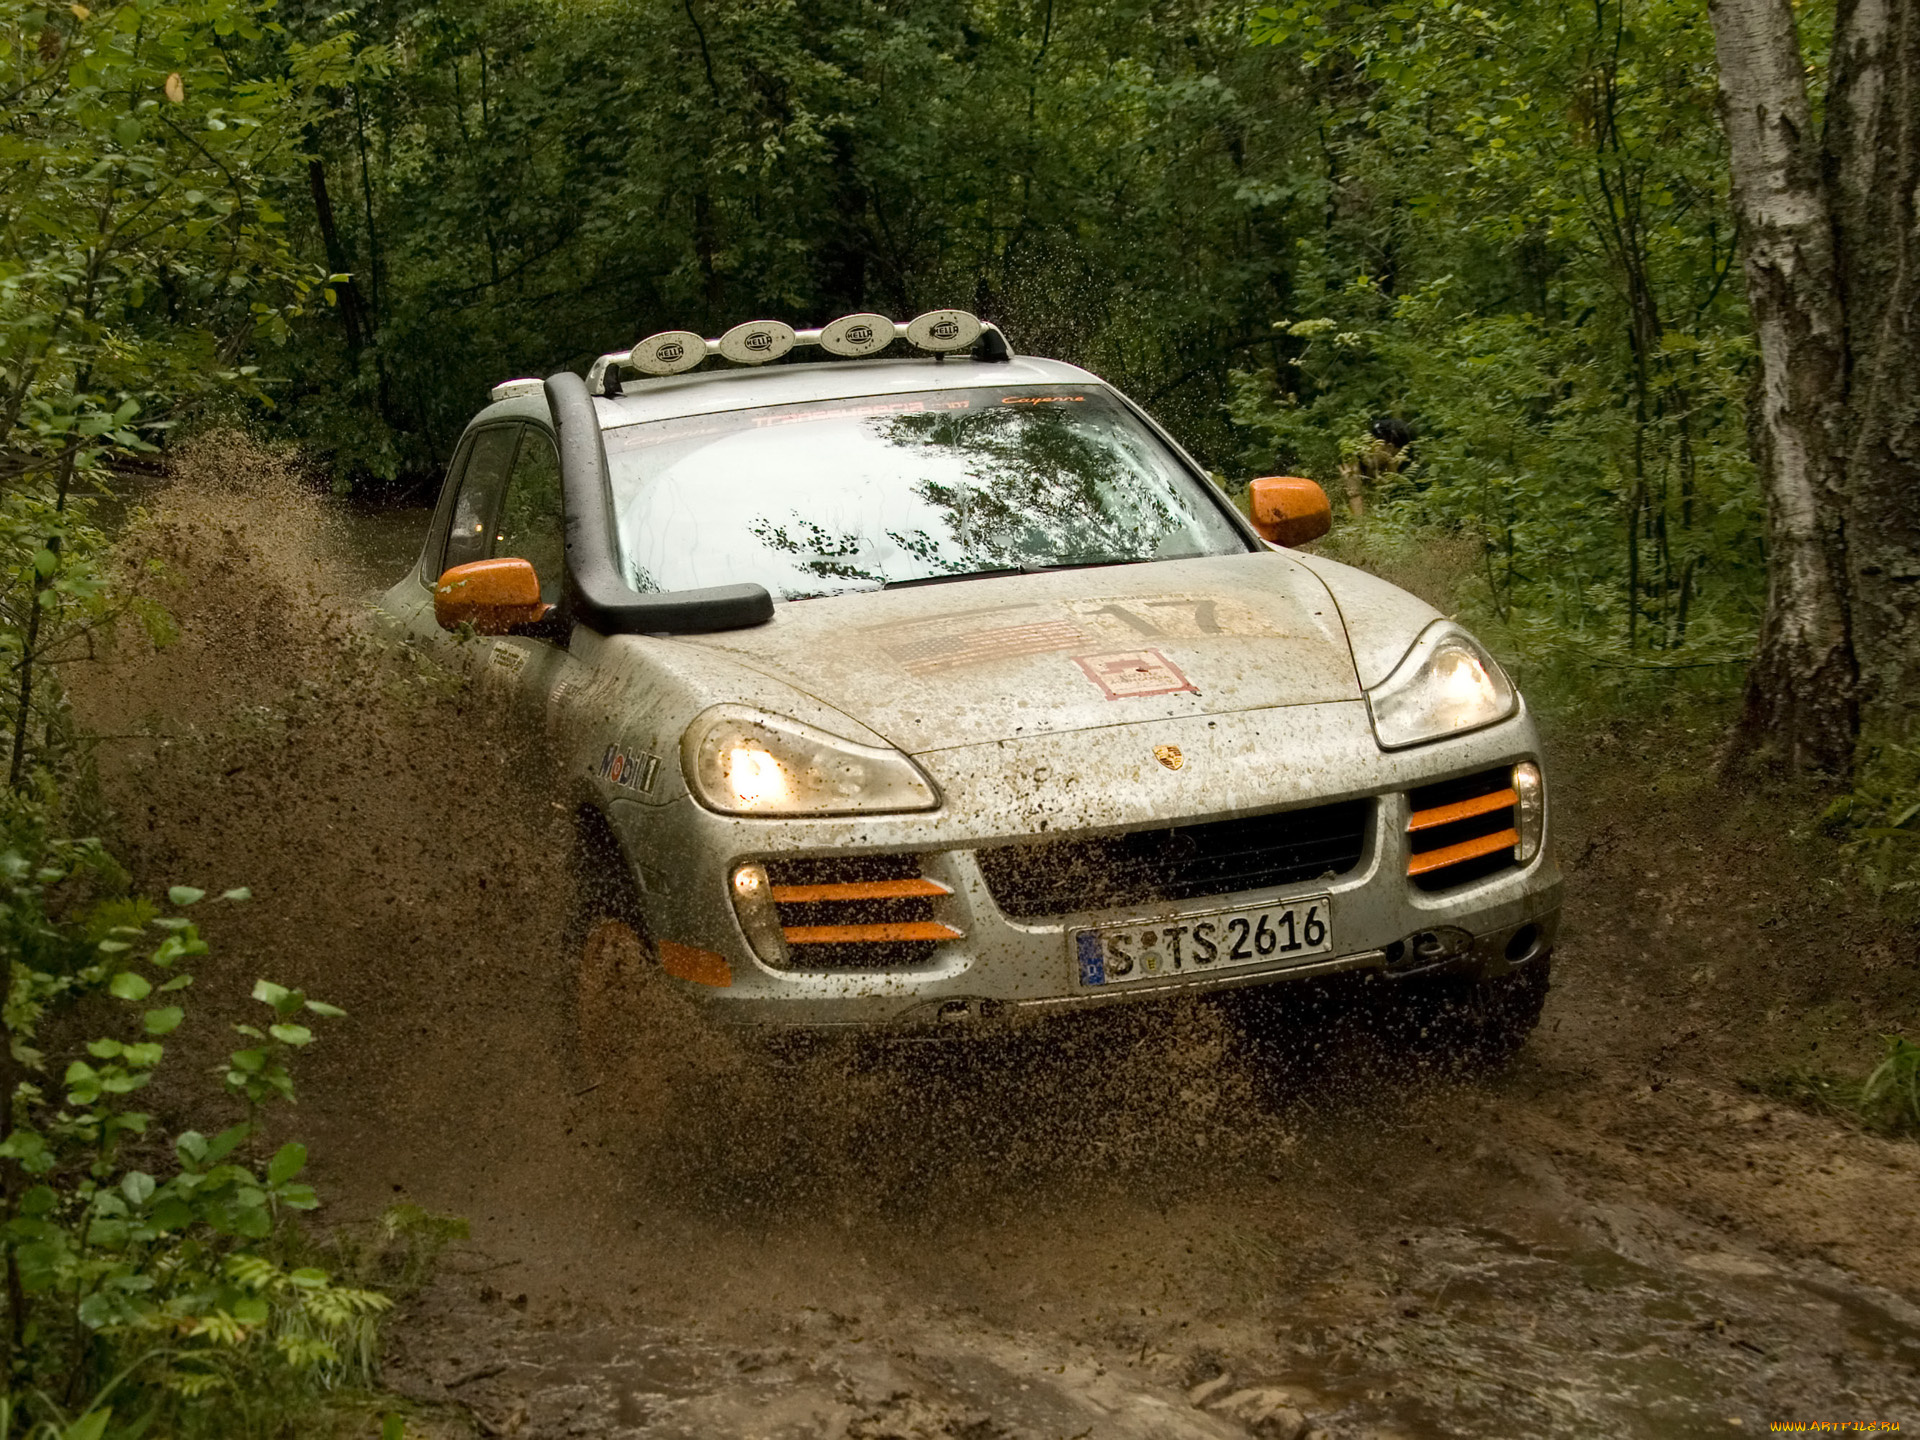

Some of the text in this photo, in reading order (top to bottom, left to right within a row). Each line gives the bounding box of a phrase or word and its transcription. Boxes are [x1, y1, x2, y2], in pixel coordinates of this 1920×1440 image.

[1001, 396, 1085, 406] Cayenne
[1105, 932, 1135, 977] S
[1227, 905, 1327, 961] 2616
